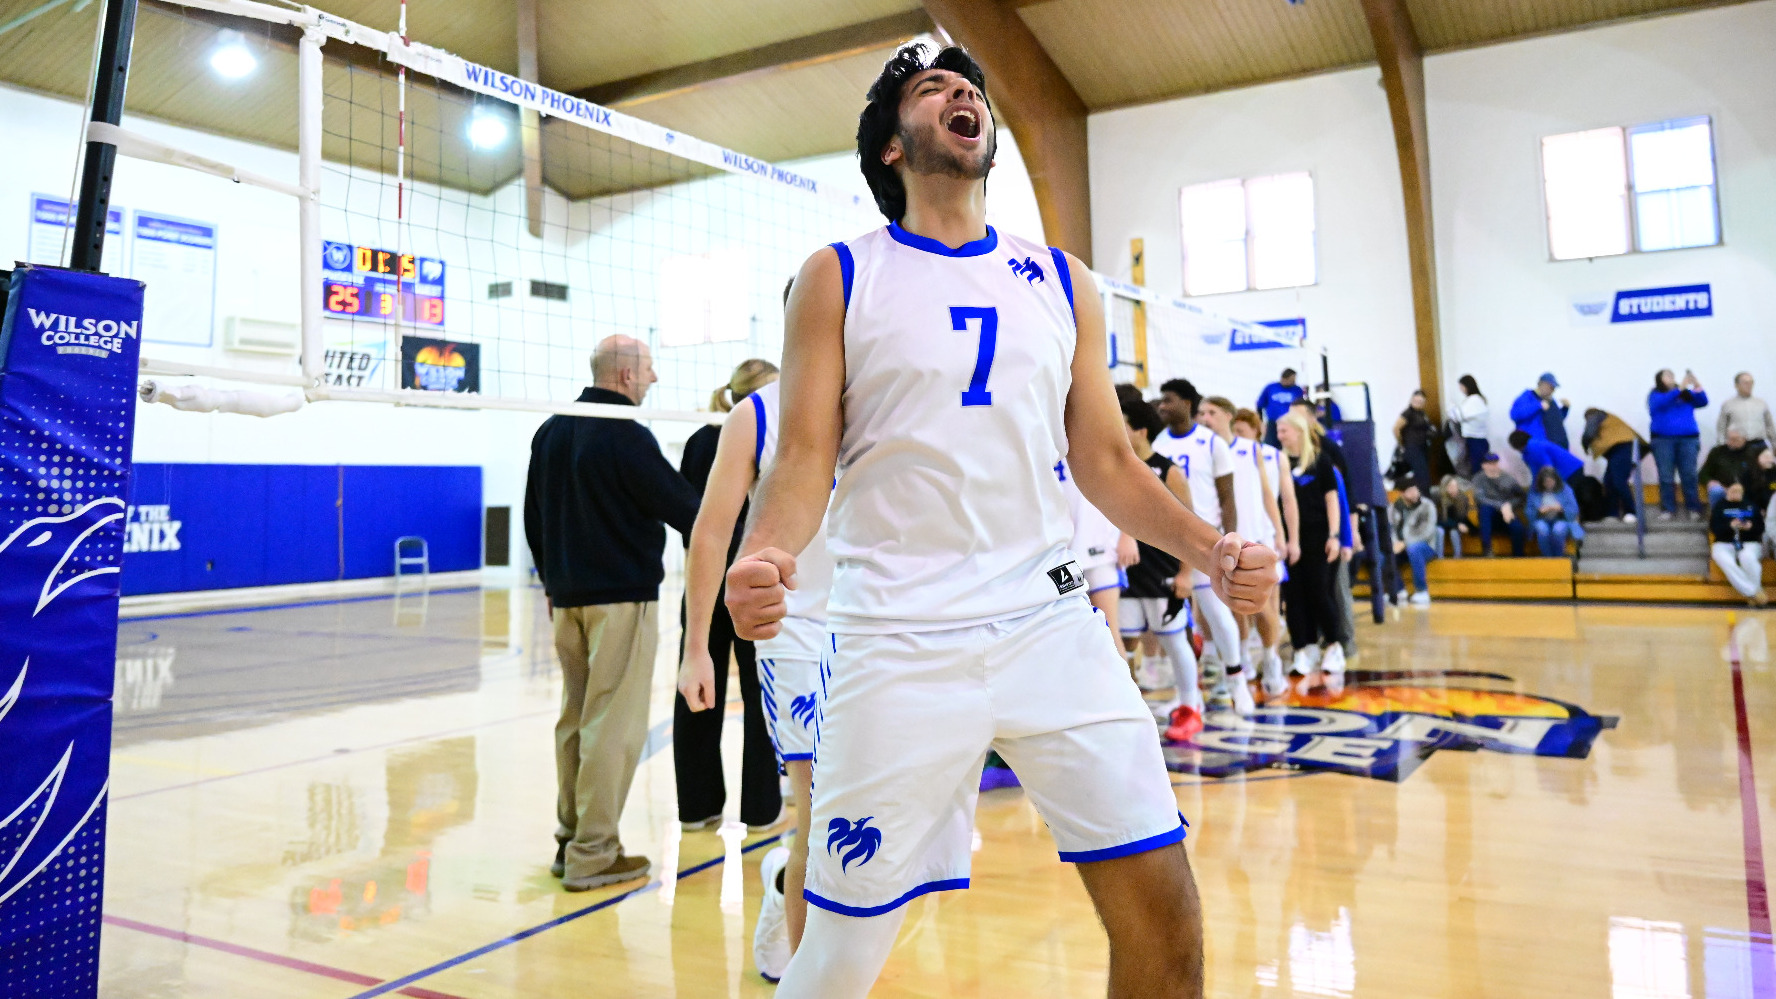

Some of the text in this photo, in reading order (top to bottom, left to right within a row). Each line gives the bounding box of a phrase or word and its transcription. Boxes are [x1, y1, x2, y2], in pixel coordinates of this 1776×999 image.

[464, 62, 612, 126] WILSON PHOENIX
[722, 150, 818, 193] WILSON PHOENIX
[328, 284, 444, 324] 25 3 13
[1617, 291, 1710, 316] STUDENTS
[27, 307, 139, 339] WILSON
[41, 331, 123, 354] COLLEGE
[948, 306, 998, 407] 7
[137, 504, 170, 522] THE
[123, 520, 182, 553] ENIX
